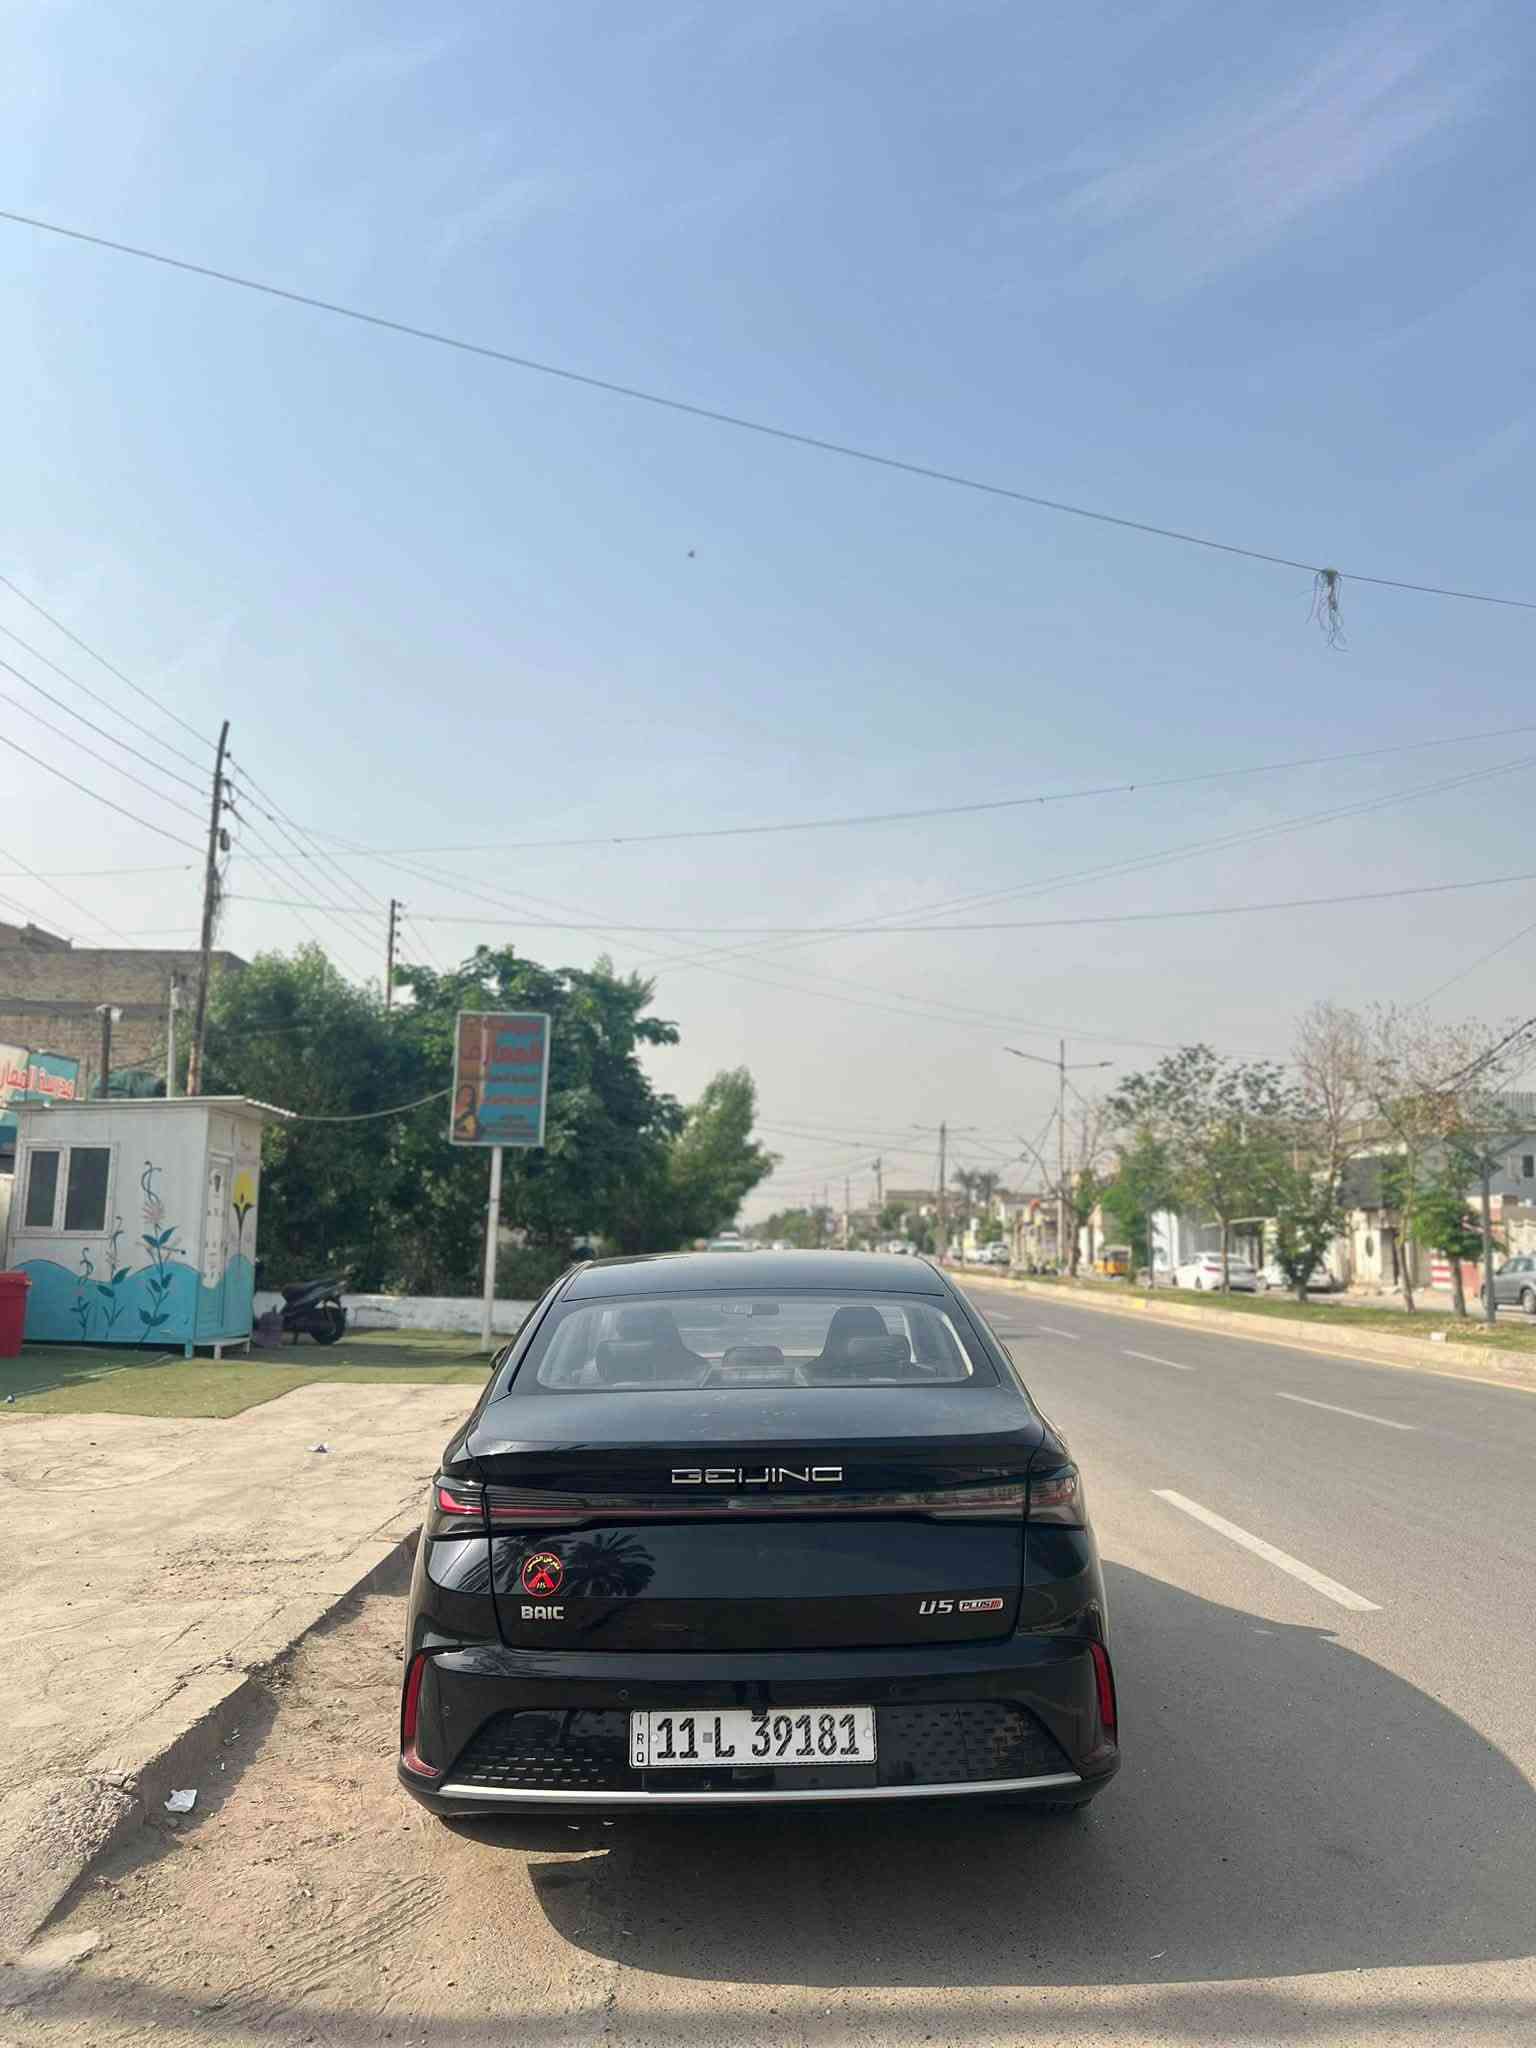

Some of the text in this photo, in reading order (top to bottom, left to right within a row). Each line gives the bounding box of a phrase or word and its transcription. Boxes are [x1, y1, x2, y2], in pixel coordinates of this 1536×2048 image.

[671, 1467, 843, 1484] BEIJING
[521, 1605, 565, 1620] BAIC
[919, 1599, 955, 1615] U5
[751, 1714, 860, 1757] 39181
